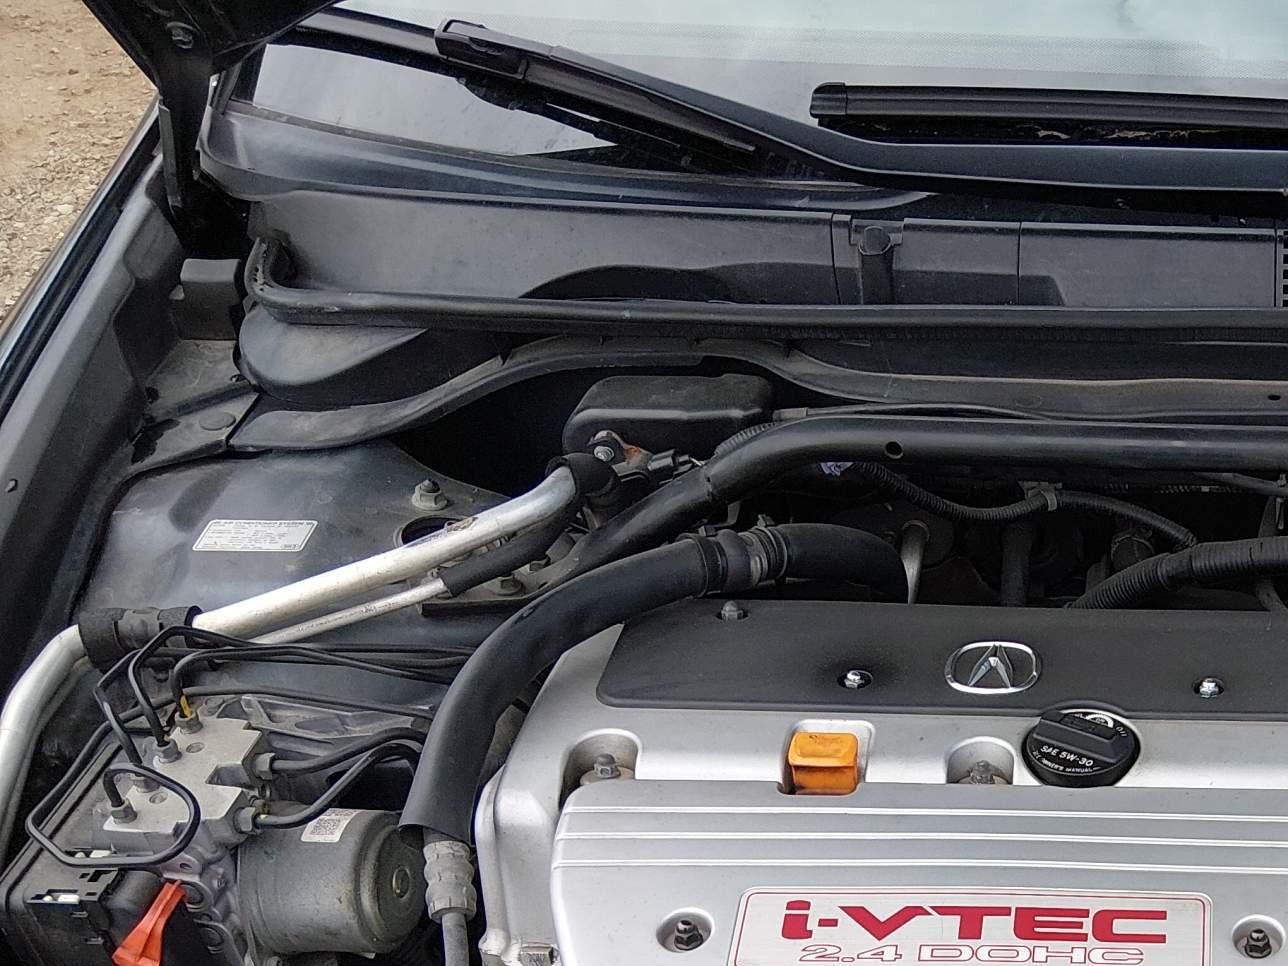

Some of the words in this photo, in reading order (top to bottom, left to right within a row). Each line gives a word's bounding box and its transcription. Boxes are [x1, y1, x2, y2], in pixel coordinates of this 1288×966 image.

[1040, 745, 1060, 756] SAE
[1059, 751, 1094, 767] 5W-30
[781, 900, 1168, 945] i-VTEC
[799, 944, 903, 964] 2.4
[917, 944, 1145, 966] DOHC
